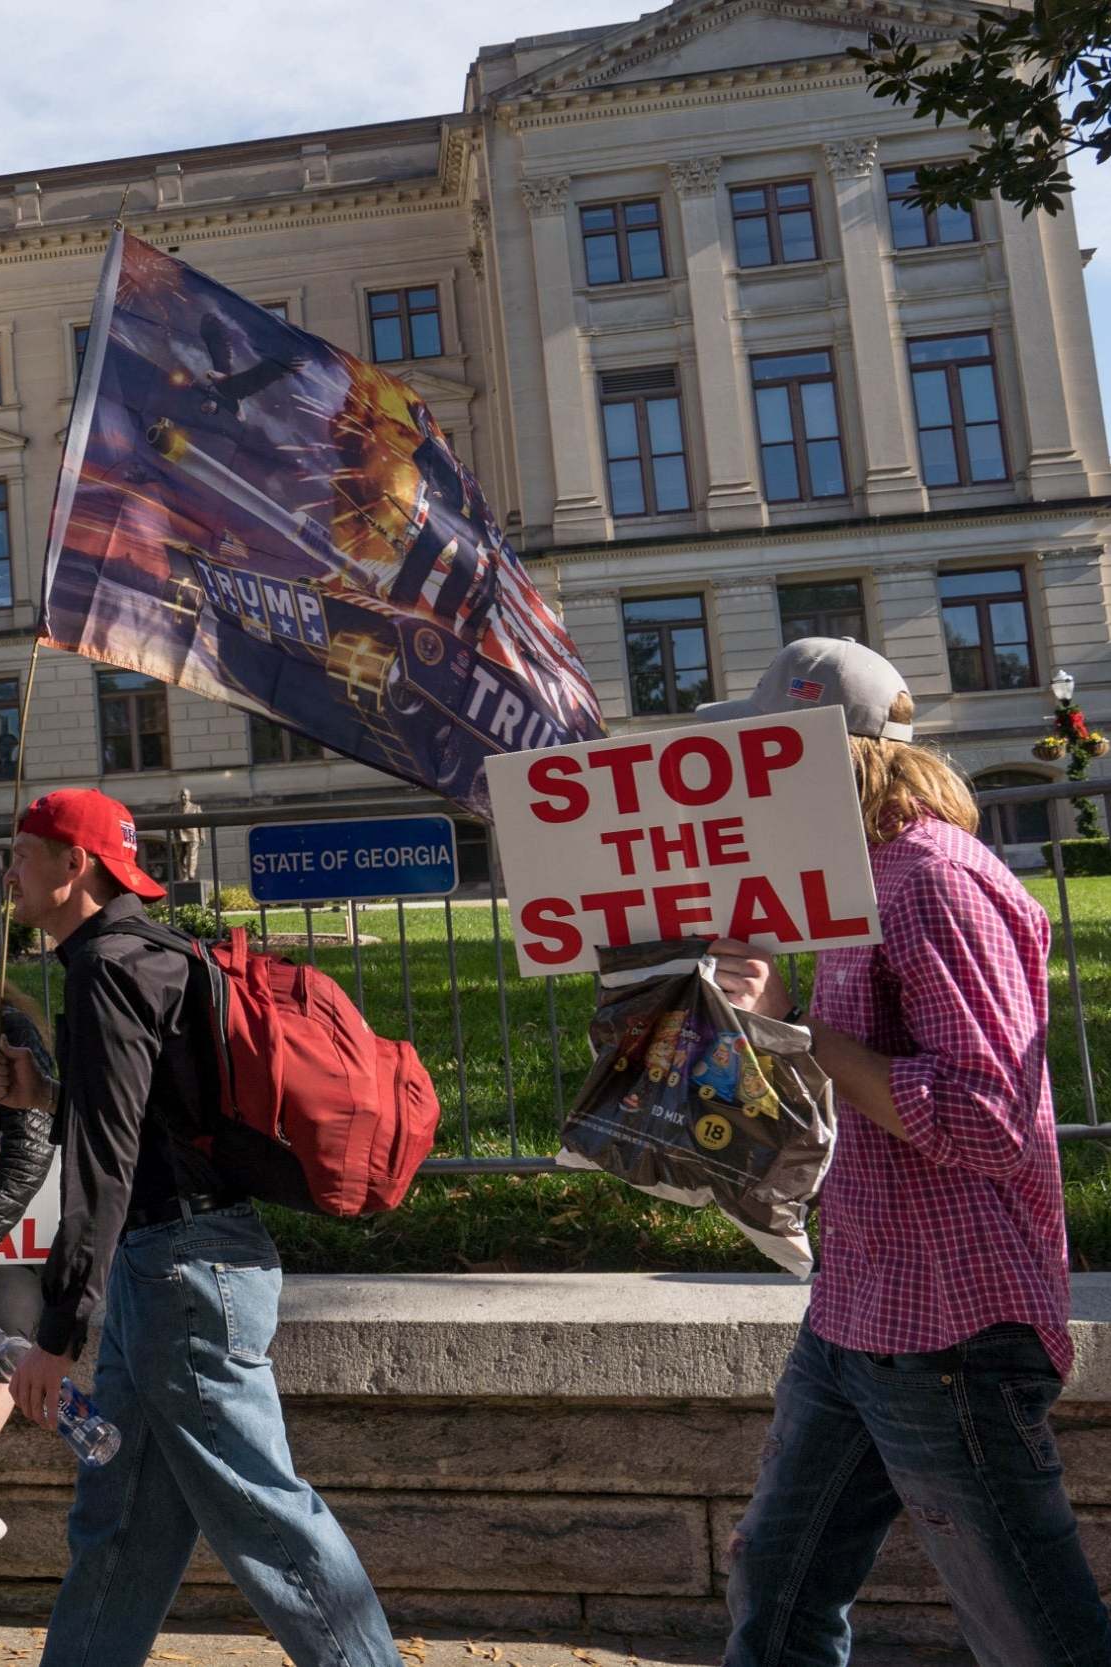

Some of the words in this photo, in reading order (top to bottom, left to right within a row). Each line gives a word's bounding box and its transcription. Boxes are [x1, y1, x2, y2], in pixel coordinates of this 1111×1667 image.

[197, 560, 320, 622] TRUMP
[527, 725, 804, 824] STOP
[252, 851, 315, 874] STATE
[320, 850, 349, 870] OF
[354, 844, 451, 869] GEORGIA
[600, 816, 751, 876] THE
[520, 869, 871, 965] STEAL
[664, 1108, 686, 1126] MIX
[704, 1121, 726, 1141] 18
